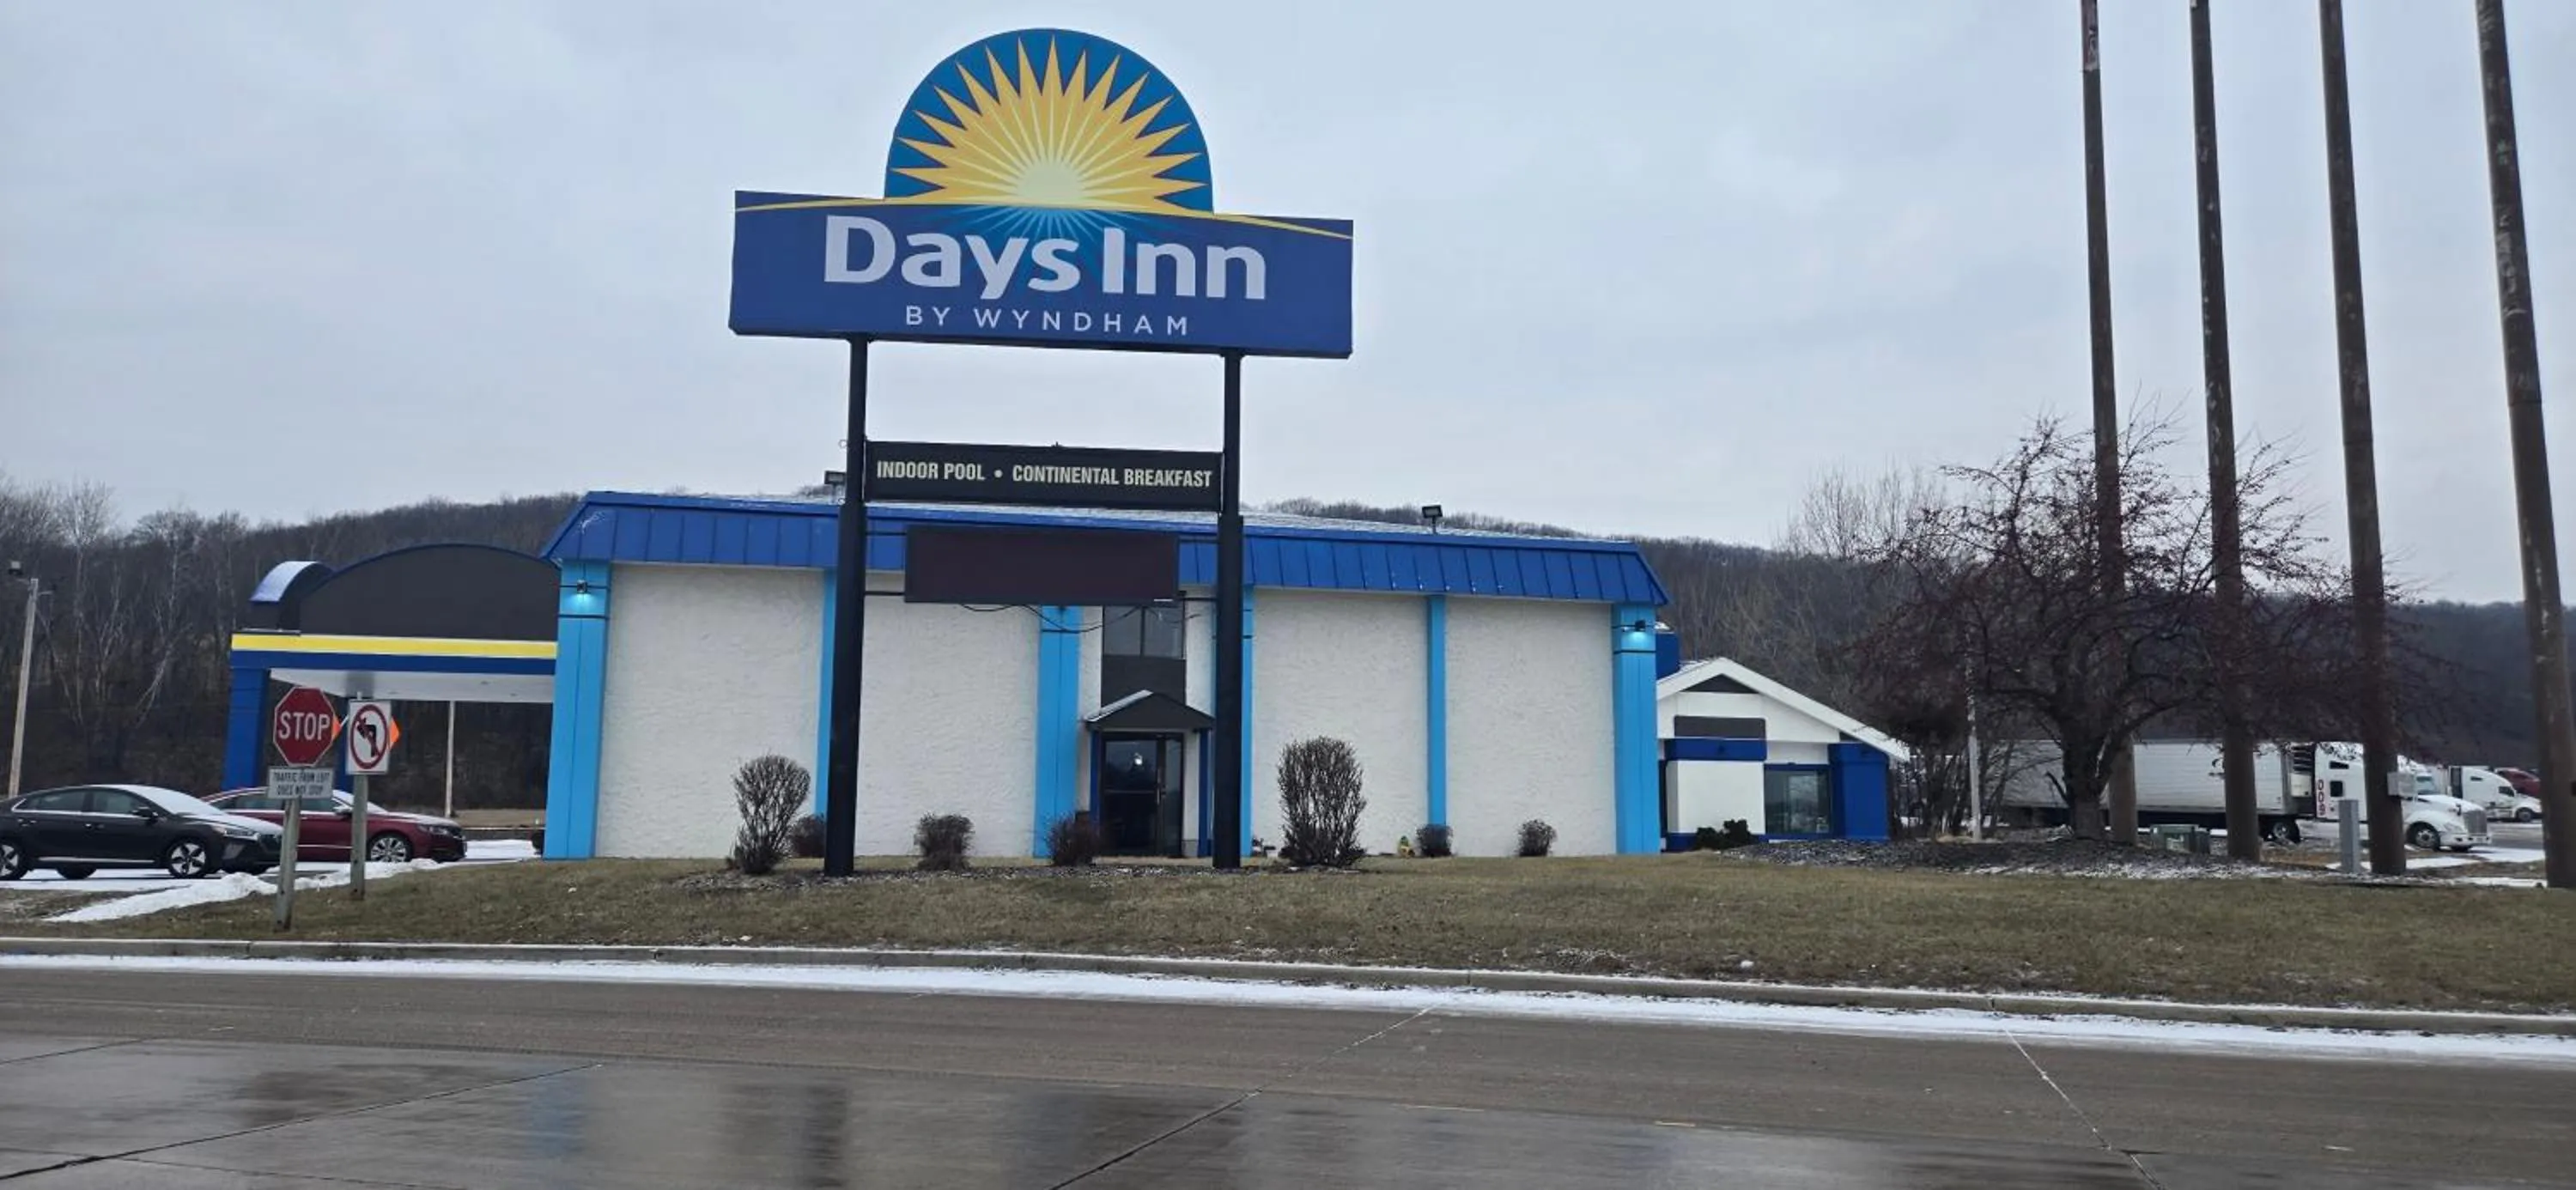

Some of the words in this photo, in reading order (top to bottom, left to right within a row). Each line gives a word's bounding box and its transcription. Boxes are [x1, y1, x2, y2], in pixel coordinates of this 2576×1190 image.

[824, 215, 1080, 300] Days
[1103, 228, 1267, 300] Inn
[906, 305, 950, 325] BY
[974, 308, 1188, 336] WYNDHAM
[877, 460, 939, 479] INDOOR
[944, 462, 986, 481] POOL
[1012, 464, 1120, 485] CONTINENTAL
[1124, 468, 1212, 488] BREAKFAST
[279, 711, 331, 741] STOP
